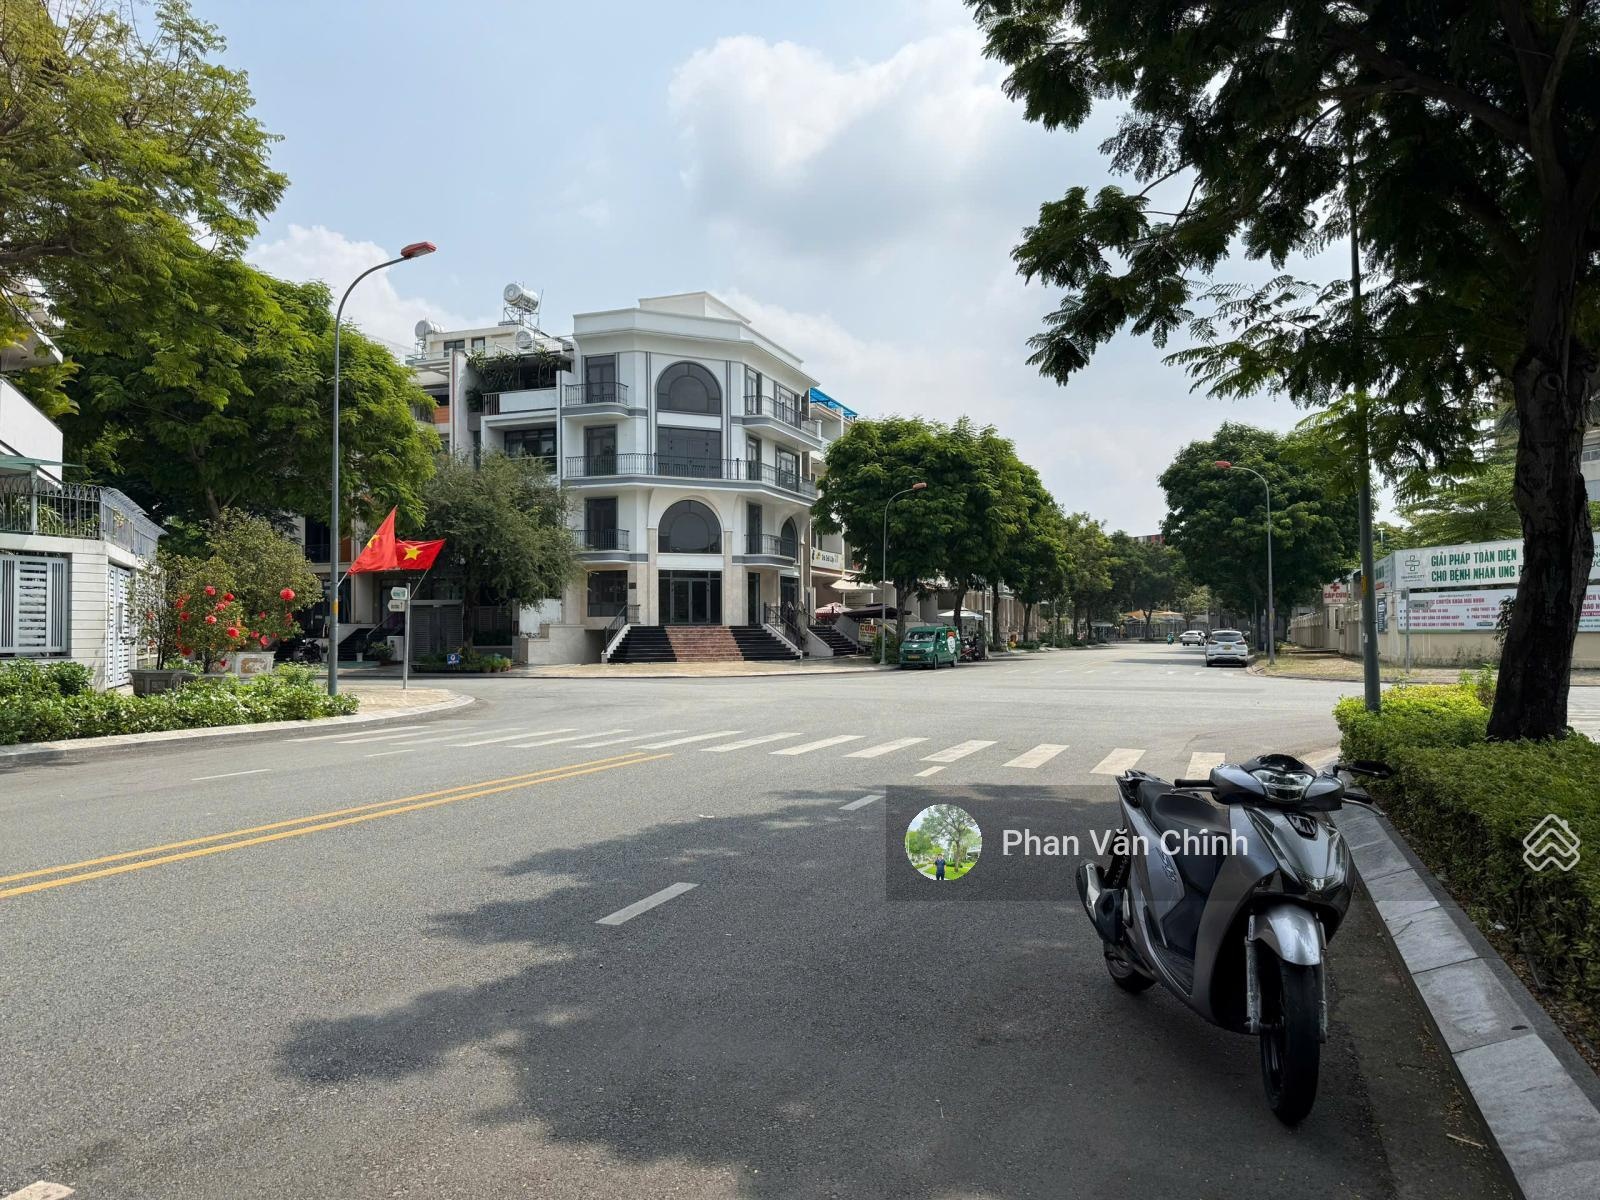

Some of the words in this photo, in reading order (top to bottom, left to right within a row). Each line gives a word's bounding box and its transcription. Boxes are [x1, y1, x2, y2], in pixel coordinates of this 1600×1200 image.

[1431, 551, 1447, 567] GIẢI
[1449, 551, 1471, 566] PHÁP
[1473, 549, 1495, 563] TOÀN
[1497, 547, 1517, 563] DIỆN
[1431, 570, 1447, 582] CHO
[1449, 568, 1471, 583] BỆNH
